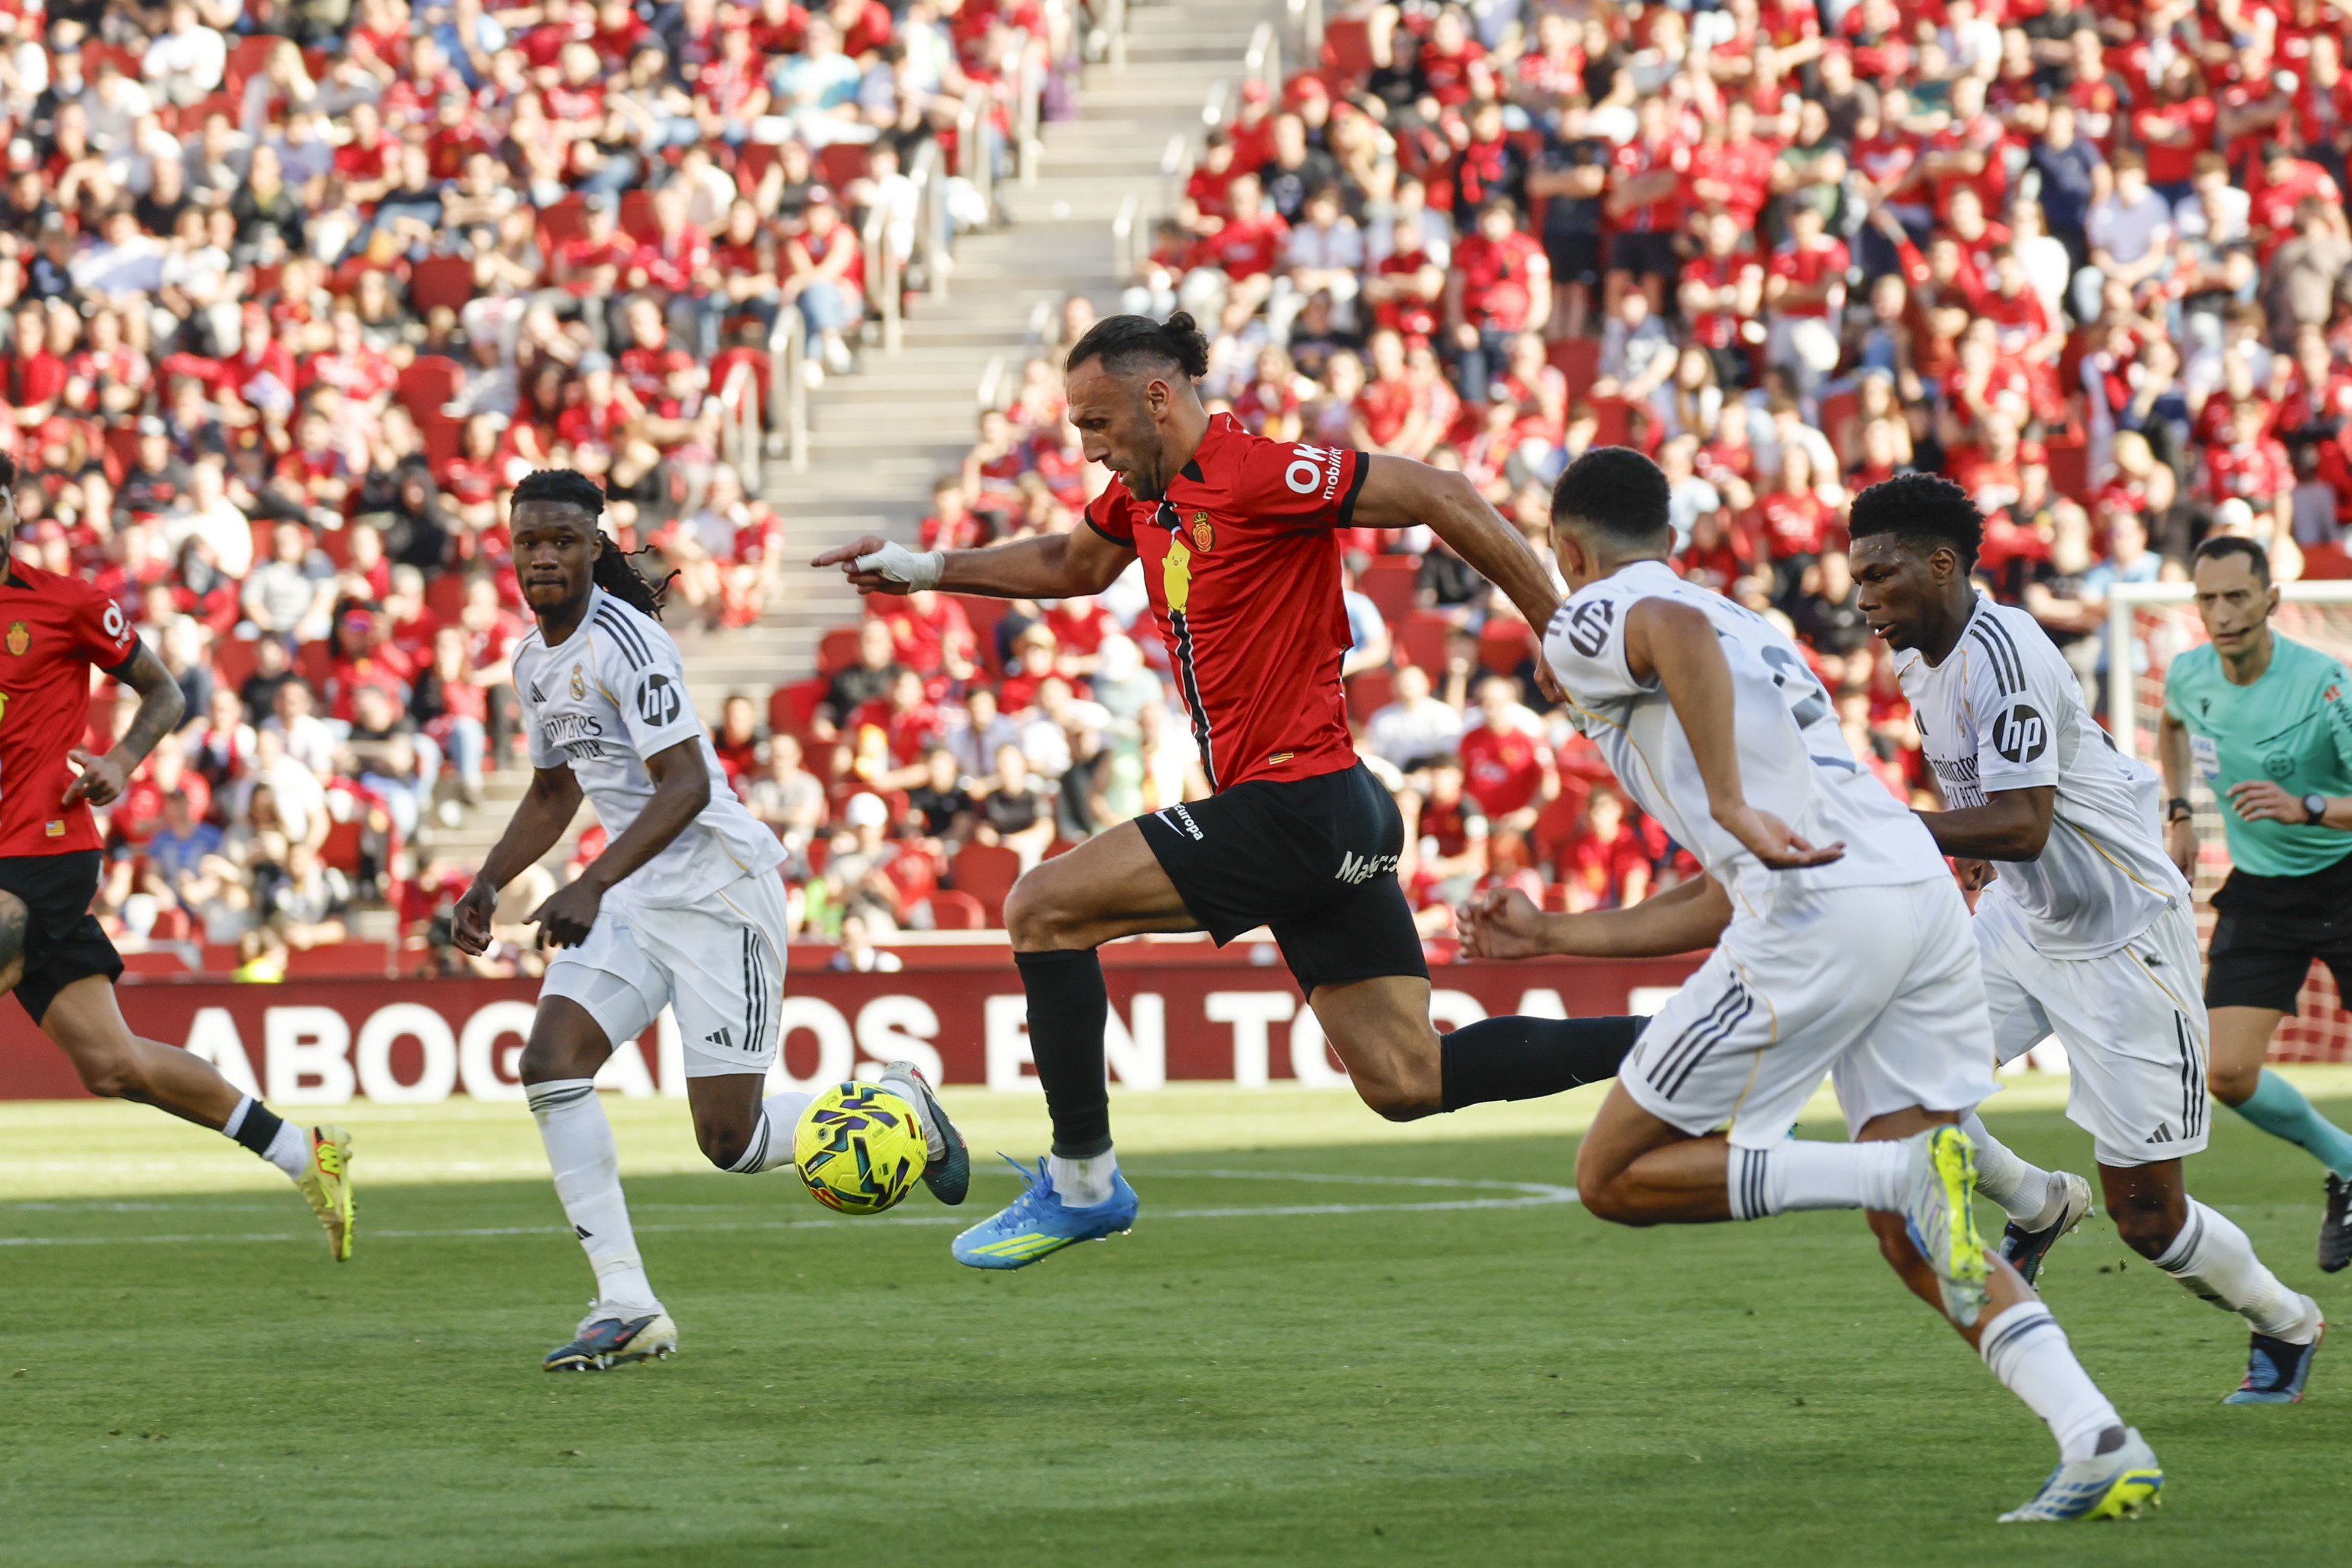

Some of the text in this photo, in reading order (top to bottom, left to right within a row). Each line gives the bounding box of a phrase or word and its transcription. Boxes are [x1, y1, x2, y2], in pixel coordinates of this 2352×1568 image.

[1285, 443, 1329, 495] OK
[641, 674, 677, 727] hp
[541, 715, 603, 741] mirates
[2000, 704, 2043, 763] hp
